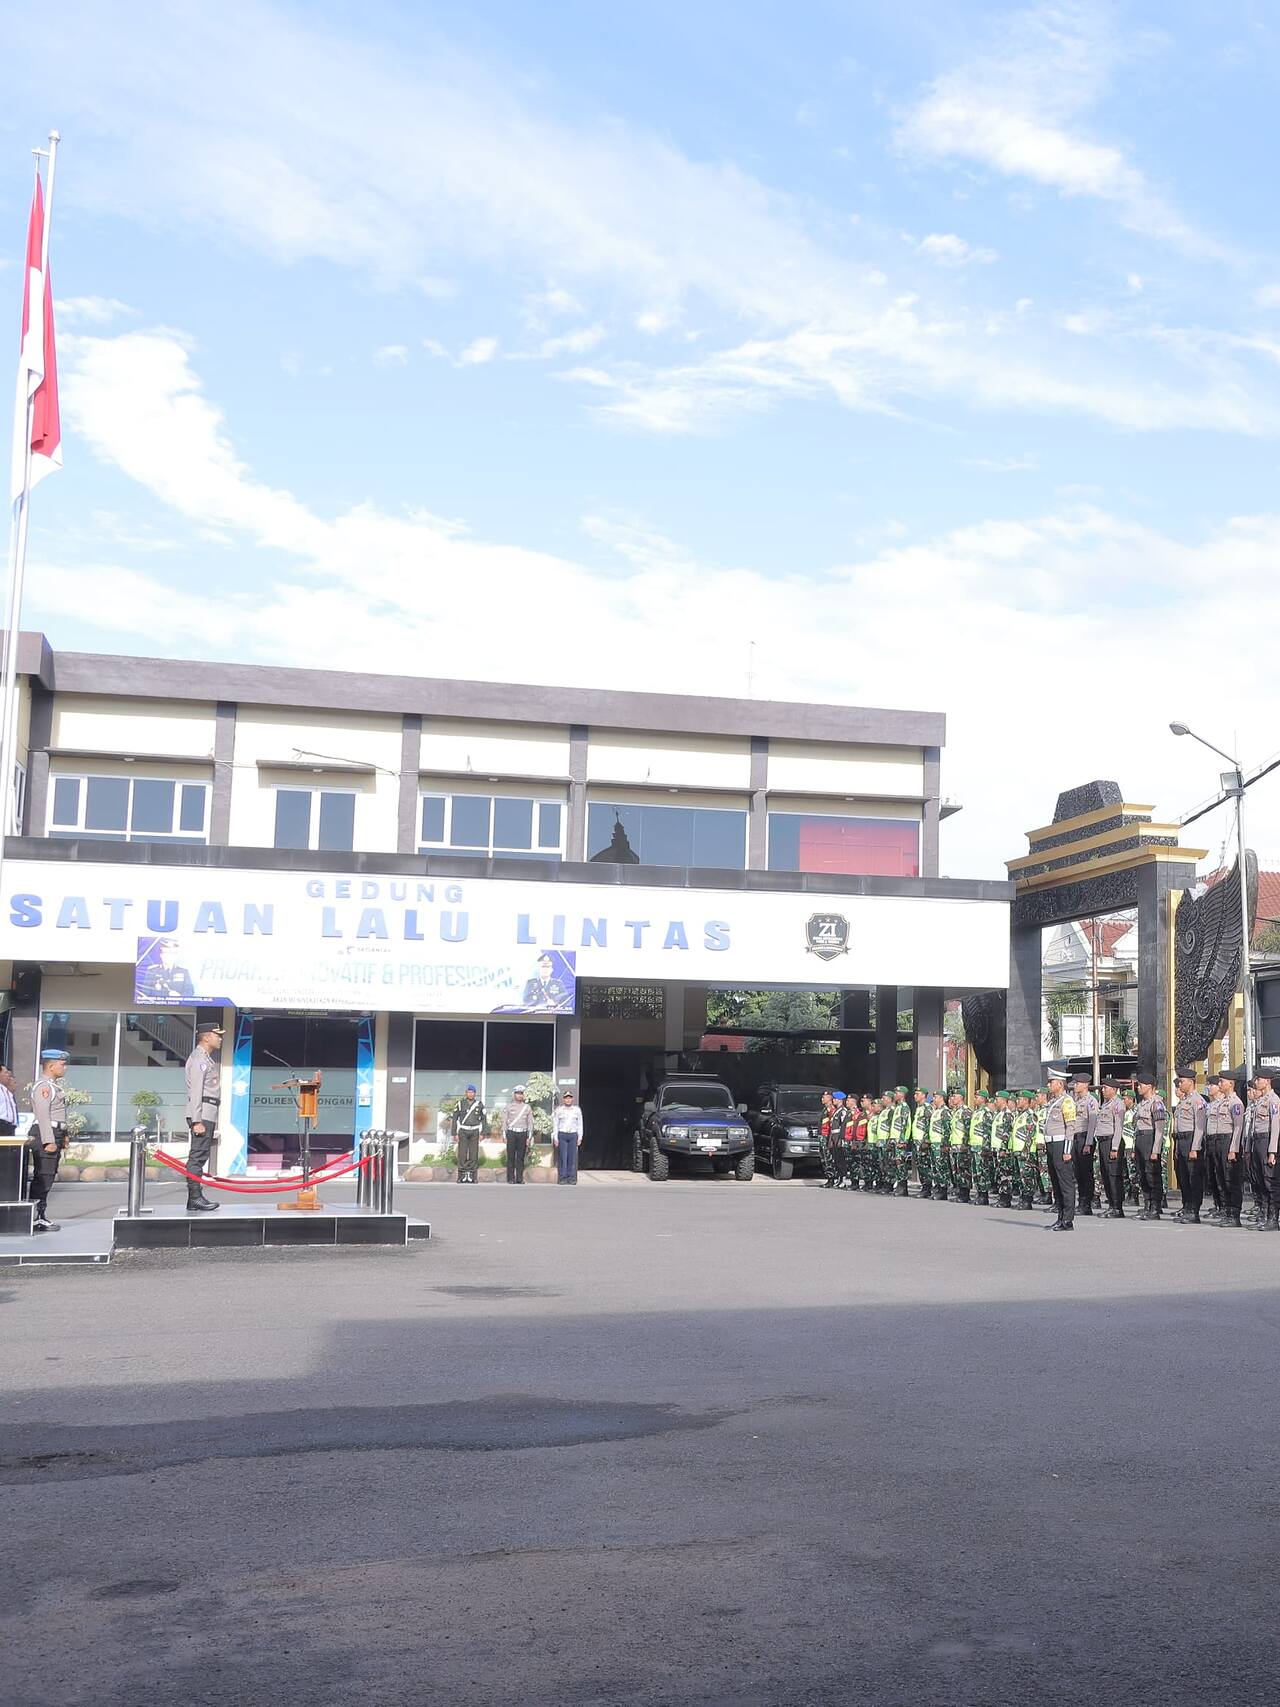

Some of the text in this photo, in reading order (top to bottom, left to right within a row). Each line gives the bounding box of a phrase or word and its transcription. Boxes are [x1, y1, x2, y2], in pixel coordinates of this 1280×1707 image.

[306, 879, 465, 903] GEDUNG
[9, 893, 731, 951] SATUAN LALU LINTAS
[818, 922, 837, 937] ZI
[381, 962, 394, 985] &
[254, 1096, 294, 1105] POLRES
